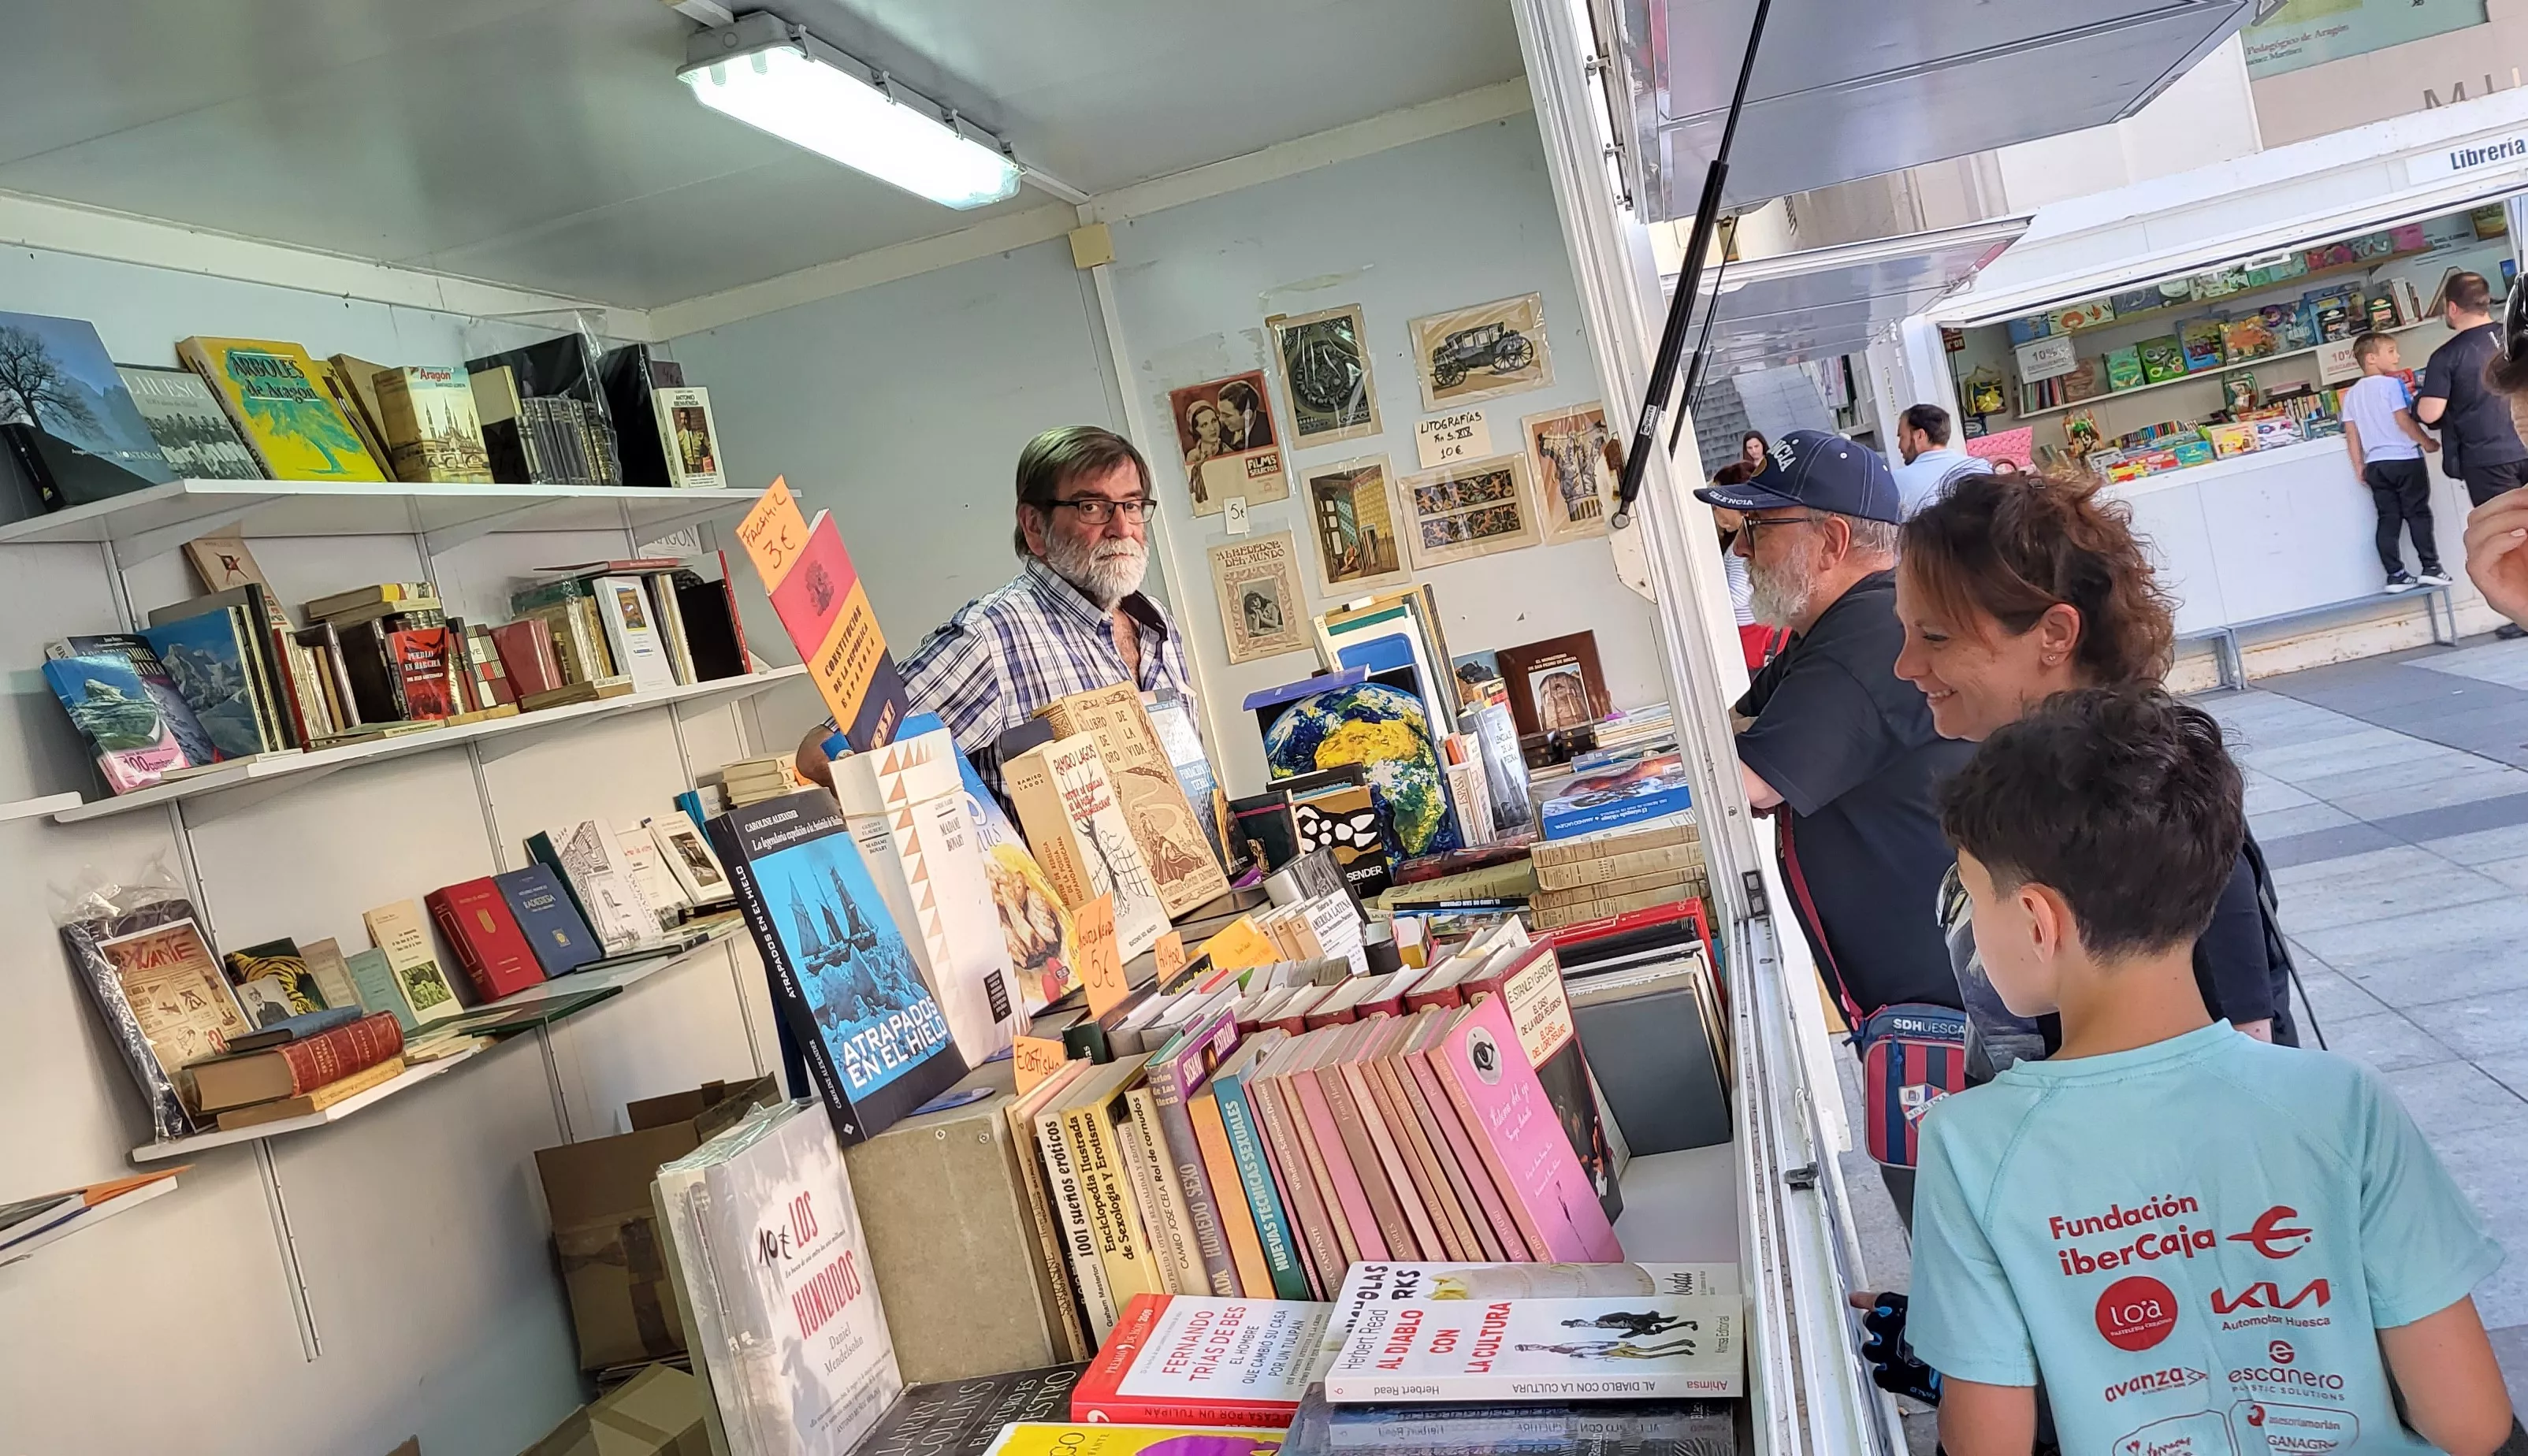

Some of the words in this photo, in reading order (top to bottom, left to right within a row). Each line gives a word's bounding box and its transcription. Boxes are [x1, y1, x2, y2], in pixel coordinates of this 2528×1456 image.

[2450, 137, 2526, 170] Librería
[419, 368, 452, 381] Aragón
[1420, 410, 1483, 435] LITOGRAFÍAS
[1247, 454, 1277, 472] FILMS
[1249, 463, 1279, 477] SELECTOS
[1229, 503, 1245, 520] 5€
[824, 604, 862, 677] CONSTITUCIÓN
[833, 677, 843, 693] DE
[841, 665, 849, 681] LA
[847, 622, 869, 667] REPÚBLICA
[1086, 715, 1107, 731] LIBRO
[1117, 710, 1128, 723] DE
[1099, 734, 1111, 748] DE
[1124, 727, 1136, 740] LA
[1075, 744, 1098, 766] LAGOS
[1105, 750, 1121, 764] ORO
[1126, 741, 1147, 757] VIDA
[122, 756, 150, 774] 100
[1017, 773, 1043, 786] RAMIRO
[1019, 778, 1044, 792] LAGOS
[744, 817, 773, 833] CAROLINE
[1053, 849, 1065, 872] POESIA
[1055, 834, 1084, 902] HISPANOAMERICANA
[1346, 865, 1384, 882] SENDER
[734, 864, 755, 900] HIELO
[1053, 871, 1061, 881] DE
[1061, 874, 1069, 883] LA
[1065, 883, 1073, 893] DE
[749, 898, 761, 916] EL
[1333, 897, 1351, 917] LATINA
[755, 914, 769, 933] EN
[762, 931, 798, 1001] ATRAPADOS
[1091, 949, 1115, 988] 5€
[1513, 975, 1536, 1001] STANLEY
[1537, 995, 1548, 1011] CASO
[842, 994, 939, 1064] ATRAPADOS
[1213, 1020, 1239, 1057] ESTRADA
[1545, 1021, 1556, 1037] CASO
[1892, 1018, 1965, 1035] SDHUESCA
[807, 1037, 830, 1078] ALEXANDER
[848, 1057, 883, 1089] EN
[882, 1038, 909, 1073] EL
[905, 1015, 949, 1058] HIELO
[1184, 1051, 1203, 1087] SUSANA
[823, 1075, 845, 1110] CAROLINE
[1129, 1094, 1156, 1150] cornudos
[1223, 1098, 1257, 1163] SEXUALES
[1039, 1117, 1073, 1178] eróticos
[1065, 1112, 1095, 1175] Ilustrada
[1078, 1109, 1109, 1171] Erotismo
[1122, 1124, 1142, 1164] EROTISMO
[1145, 1148, 1160, 1164] de
[1148, 1162, 1165, 1184] Rol
[1177, 1160, 1206, 1199] SEXO
[1281, 1150, 1303, 1191] Wilhelmine
[1136, 1172, 1159, 1220] SEXUALIDAD
[1155, 1183, 1174, 1209] CELA
[1241, 1159, 1273, 1216] TÉCNICAS
[1056, 1174, 1088, 1228] sueños
[1083, 1171, 1121, 1254] Enciclopedia
[1101, 1179, 1133, 1245] Sexología
[788, 1190, 819, 1250] LOS
[1162, 1206, 1181, 1234] JOSE
[1188, 1198, 1224, 1260] HÚMEDO
[2048, 1193, 2199, 1241] Fundación
[1071, 1224, 1096, 1259] 1001
[1152, 1224, 1169, 1250] OTROS
[1261, 1219, 1292, 1272] NUEVAS
[1308, 1223, 1335, 1272] CANTANTE
[1120, 1242, 1138, 1261] de
[1169, 1230, 1193, 1271] CAMILO
[2057, 1224, 2217, 1277] iberCaja
[1087, 1262, 1107, 1298] Masterton
[1162, 1255, 1178, 1284] FREUD
[791, 1249, 861, 1340] HUNDIDOS
[2210, 1277, 2331, 1314] KIA
[1098, 1297, 1117, 1329] Graham
[1136, 1306, 1154, 1324] 2009
[1222, 1306, 1247, 1328] BES
[1269, 1309, 1289, 1329] CASA
[2221, 1314, 2283, 1332] Automotor
[2285, 1316, 2331, 1328] Huesca
[827, 1321, 852, 1350] Daniel
[1130, 1319, 1146, 1337] HOY
[1210, 1328, 1236, 1348] DE
[1234, 1324, 1260, 1354] HOMBRE
[1264, 1328, 1277, 1340] SU
[1281, 1320, 1306, 1350] TULIPÁN
[1339, 1331, 1377, 1372] Herbert
[1361, 1307, 1389, 1334] Read
[1384, 1308, 1426, 1355] DIABLO
[1429, 1327, 1462, 1355] CON
[1475, 1301, 1513, 1358] CULTURA
[822, 1335, 864, 1376] Mendelsohn
[1162, 1310, 1215, 1375] FERNANDO
[1250, 1339, 1274, 1369] CAMBIÓ
[1276, 1350, 1288, 1361] UN
[1103, 1346, 1128, 1376] PREMIO
[1188, 1346, 1226, 1382] TRÍAS
[1229, 1354, 1246, 1365] EL
[1268, 1361, 1284, 1377] POR
[1375, 1353, 1400, 1371] AL
[1464, 1355, 1491, 1374] LA
[1242, 1361, 1261, 1385] QUE
[1642, 1380, 1656, 1392] AL
[1686, 1380, 1728, 1391] Ahimsa
[2104, 1367, 2184, 1403] avanza
[2228, 1366, 2344, 1390] escanero
[1374, 1385, 1400, 1397] Read
[1403, 1385, 1441, 1397] Herbert
[1511, 1381, 1560, 1394] CULTURA
[1561, 1381, 1575, 1393] LA
[1575, 1381, 1600, 1393] CON
[1600, 1381, 1641, 1393] DIABLO
[2280, 1387, 2345, 1402] SOLUTIONS
[903, 1380, 996, 1456] COLLINS
[968, 1430, 988, 1448] EL
[980, 1389, 1028, 1439] FUTURO
[1016, 1378, 1038, 1398] ES
[1143, 1406, 1194, 1418] TULIPÁN
[1198, 1408, 1214, 1418] UN
[1219, 1410, 1243, 1419] POR
[874, 1398, 947, 1456] LARRY
